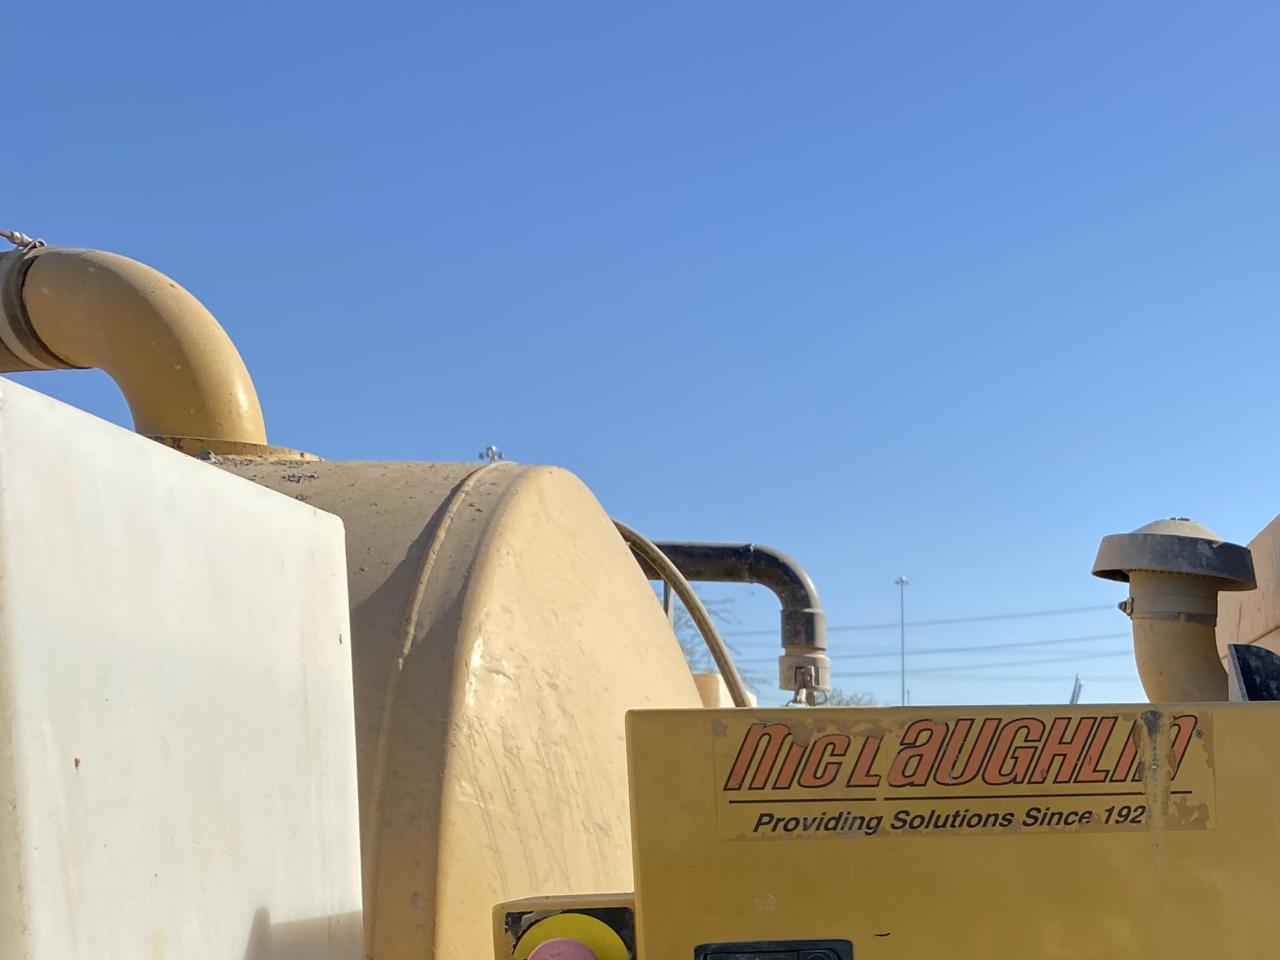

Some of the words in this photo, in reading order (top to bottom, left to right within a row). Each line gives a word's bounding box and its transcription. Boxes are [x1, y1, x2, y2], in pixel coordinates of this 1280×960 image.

[752, 811, 883, 836] Providing
[890, 808, 1015, 831] Solutions
[1022, 806, 1094, 827] Since
[1104, 804, 1147, 825] 192
